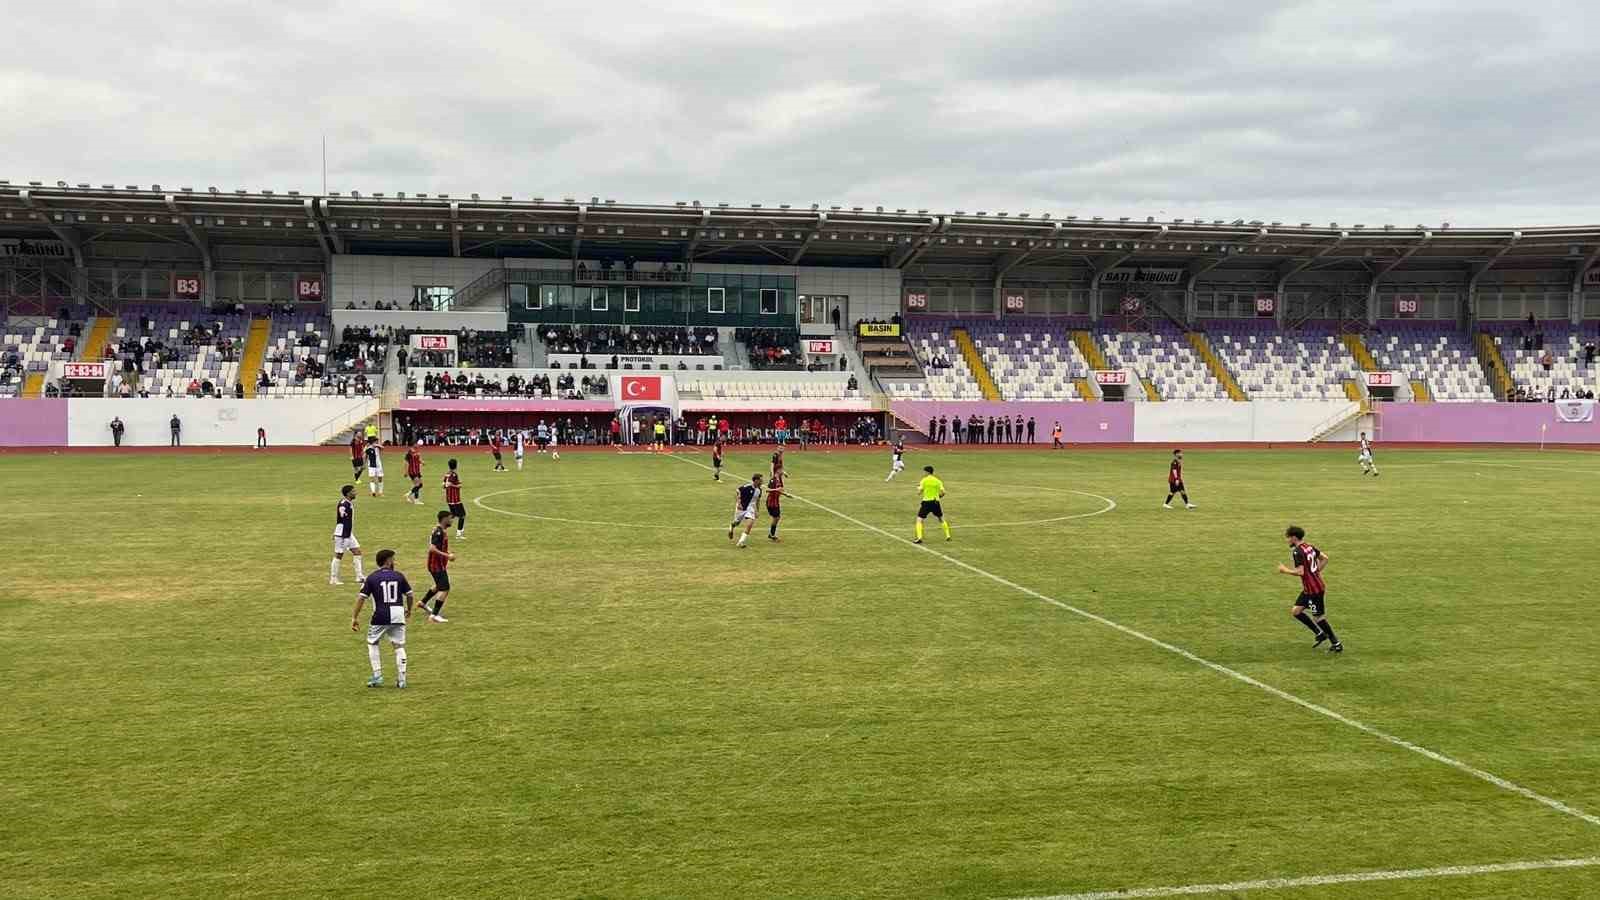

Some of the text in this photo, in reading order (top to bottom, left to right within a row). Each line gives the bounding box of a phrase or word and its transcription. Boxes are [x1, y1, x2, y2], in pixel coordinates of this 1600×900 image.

[177, 280, 199, 293] B3
[300, 282, 320, 295] B4
[909, 295, 925, 307] B5
[1007, 297, 1024, 308] B6
[1257, 299, 1273, 311] B8
[1399, 301, 1416, 312] B9
[380, 581, 398, 603] 10
